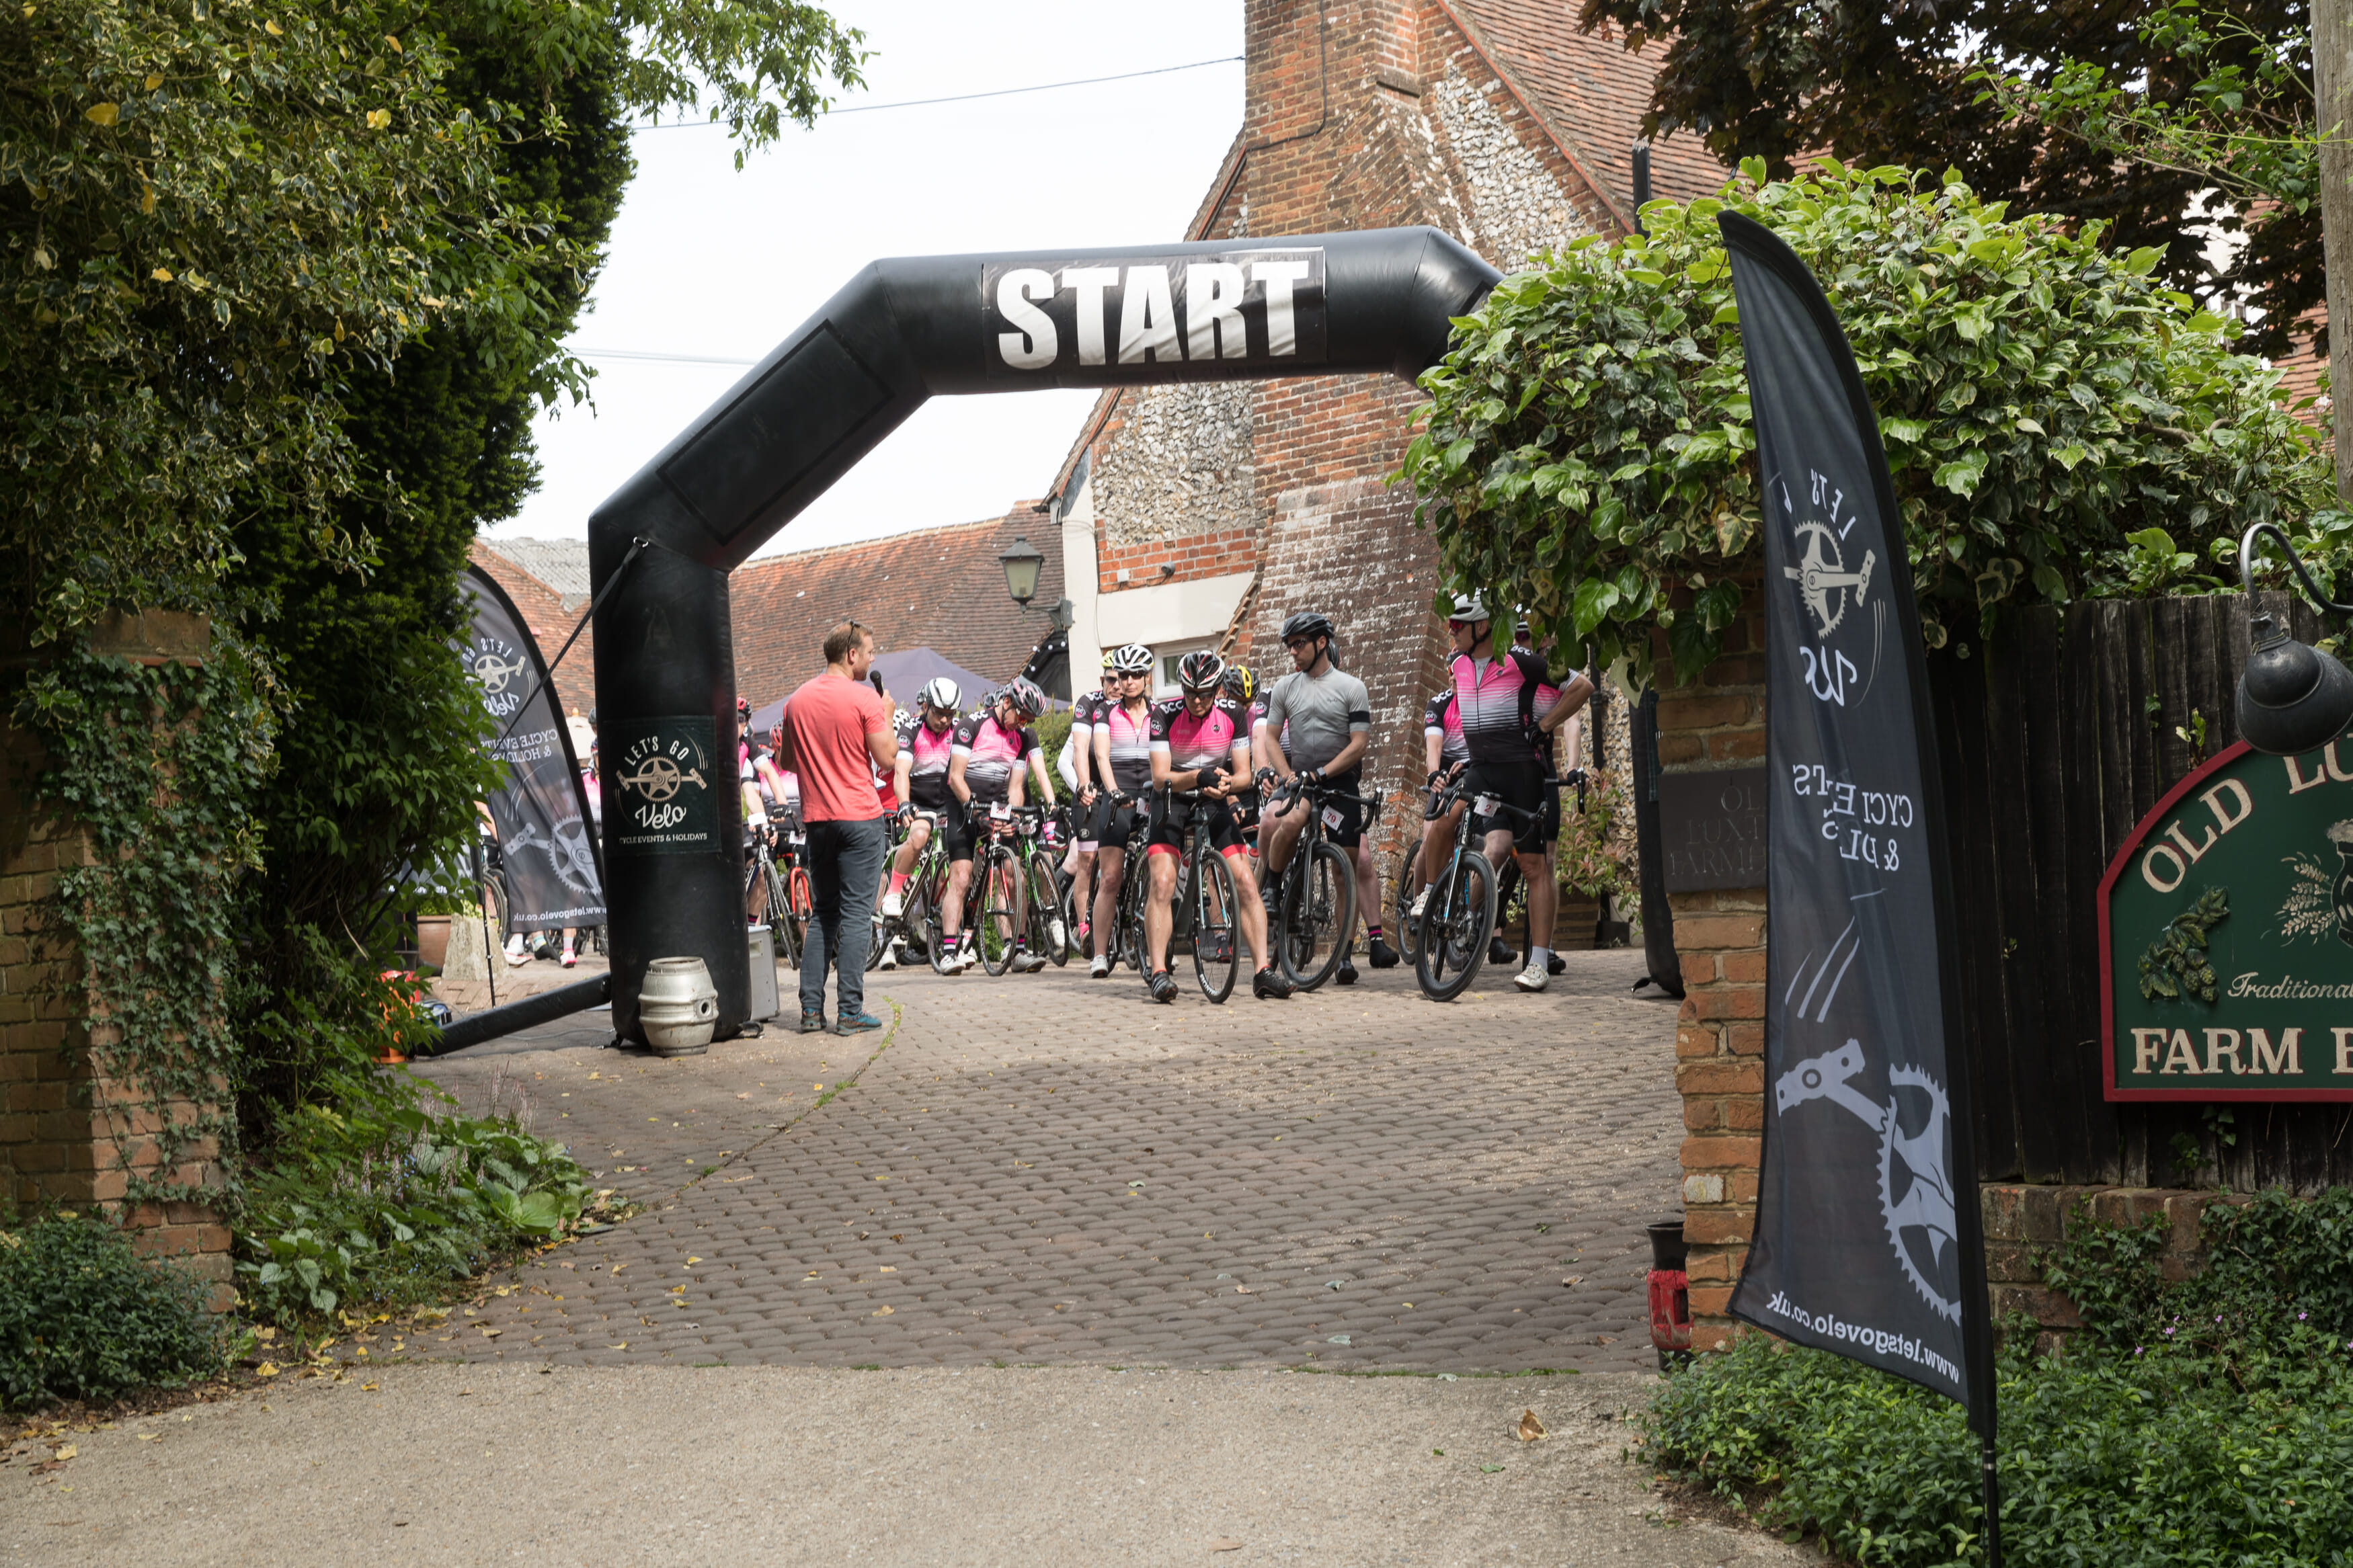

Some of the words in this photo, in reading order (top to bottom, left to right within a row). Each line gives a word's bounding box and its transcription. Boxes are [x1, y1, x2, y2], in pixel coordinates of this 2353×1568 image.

[996, 260, 1309, 370] START
[625, 736, 658, 766] LET'S
[669, 740, 690, 761] GO
[635, 803, 686, 829] Velo
[1327, 811, 1337, 823] 79
[1484, 804, 1491, 813] 2
[619, 835, 637, 844] CYCLE
[637, 834, 664, 843] EVENTS
[666, 834, 671, 842] &
[672, 833, 707, 841] HOLIDAYS
[2141, 777, 2253, 893] OLD
[2228, 972, 2353, 999] Traditional
[2130, 1026, 2304, 1075] FARM
